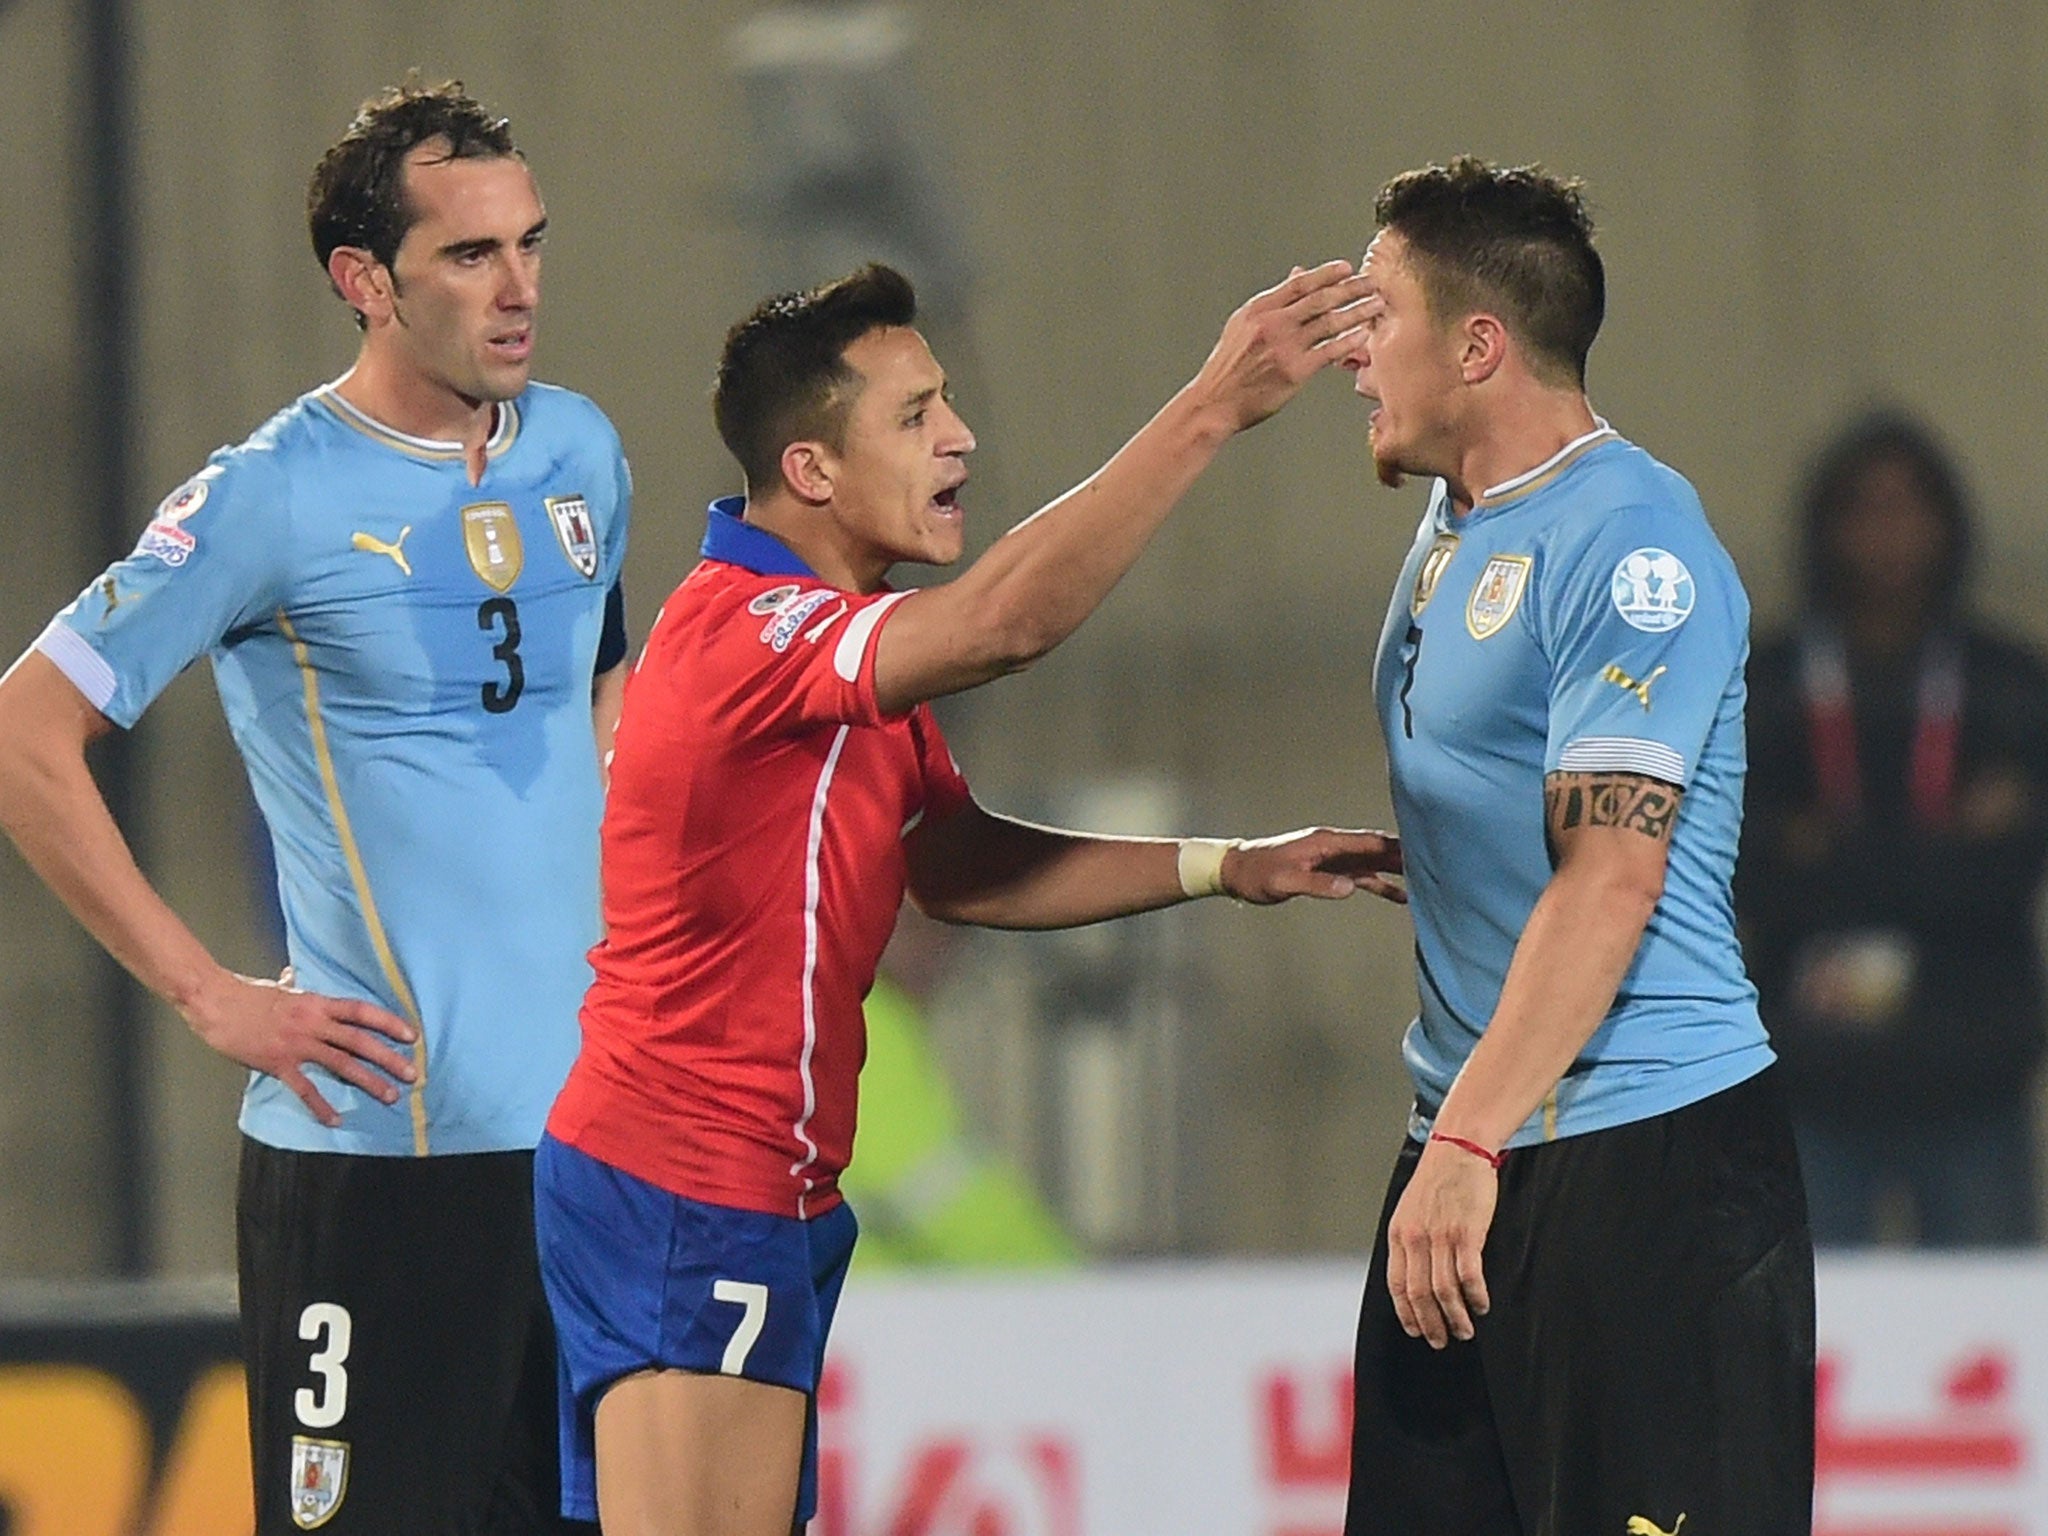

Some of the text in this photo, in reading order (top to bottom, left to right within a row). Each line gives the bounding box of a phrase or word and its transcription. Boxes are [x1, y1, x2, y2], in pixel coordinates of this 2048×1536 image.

[478, 598, 525, 714] 3
[294, 1301, 352, 1430] 3
[713, 1279, 768, 1376] 7
